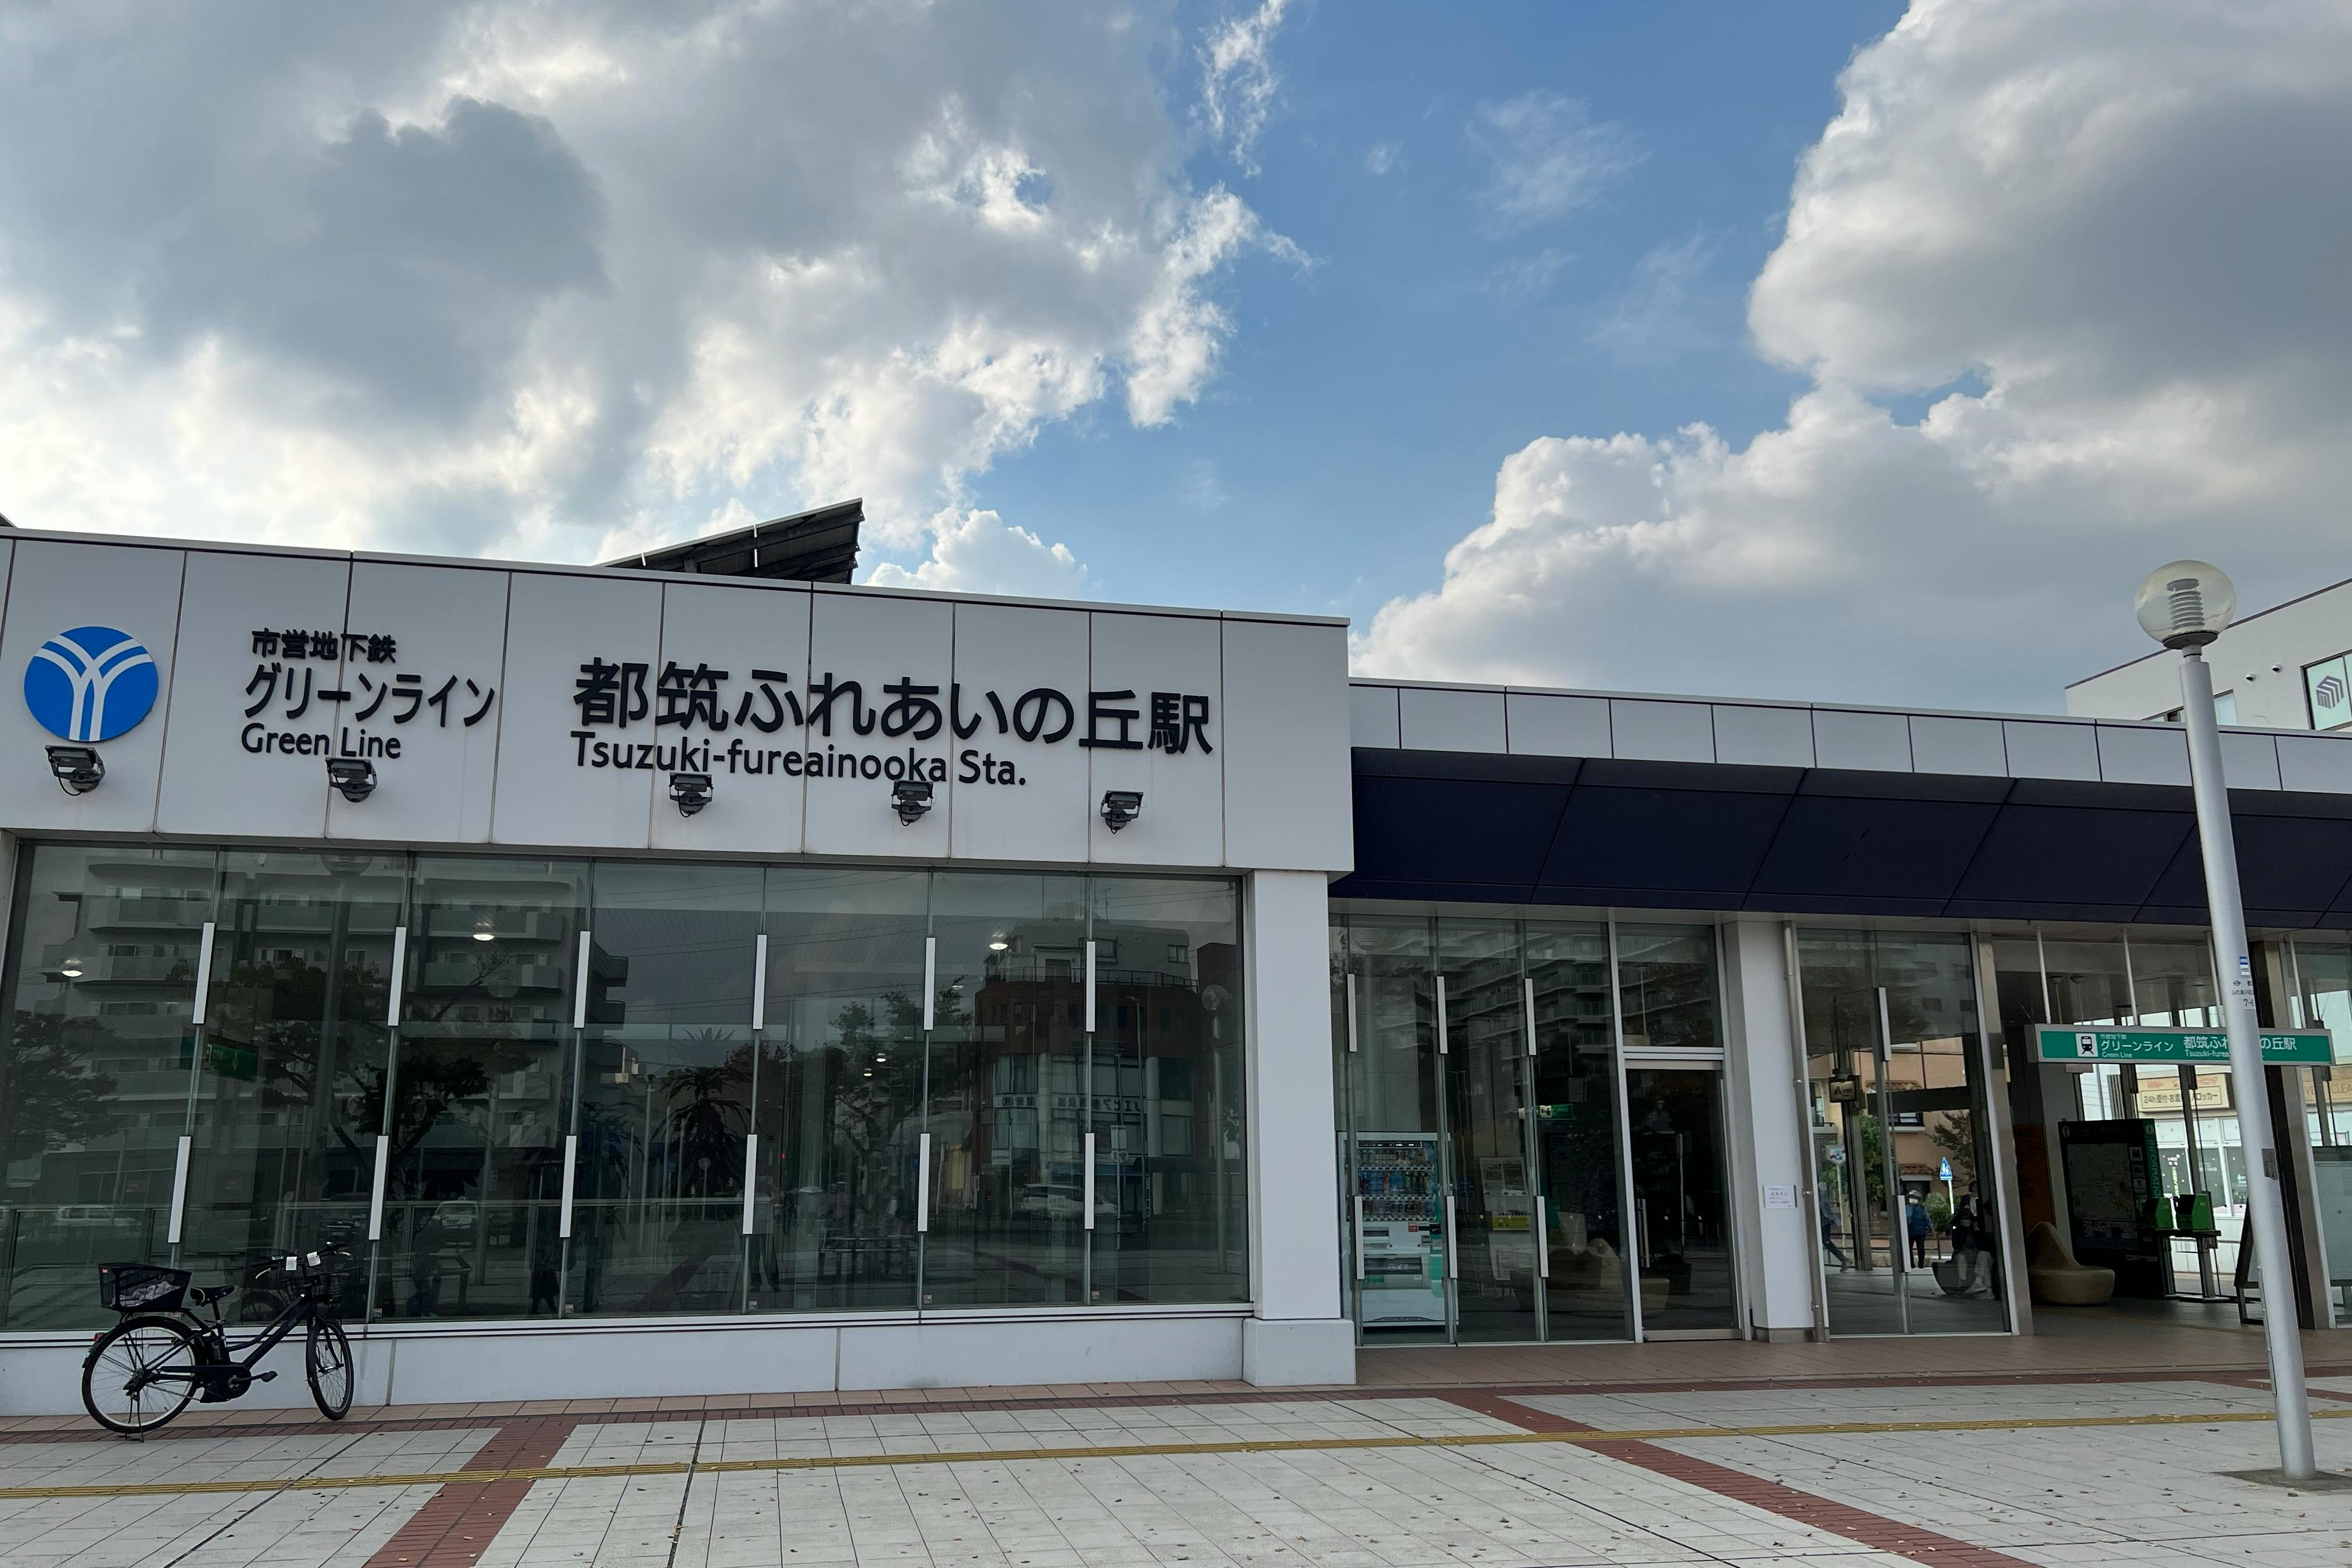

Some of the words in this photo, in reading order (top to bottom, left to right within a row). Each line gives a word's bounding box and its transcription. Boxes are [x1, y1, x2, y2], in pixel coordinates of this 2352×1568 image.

[252, 628, 397, 663] 市営地下鉄
[244, 662, 495, 727] グリーンライン
[573, 657, 1213, 754] 都筑ふれあいの丘駅
[242, 723, 330, 755] Green
[341, 727, 401, 758] Line
[570, 731, 946, 782] Tsuzuki-fureainooka
[960, 750, 1026, 786] Sta.
[2101, 1040, 2174, 1052] グリーンライン
[2148, 1139, 2163, 1199] INFORMATIO
